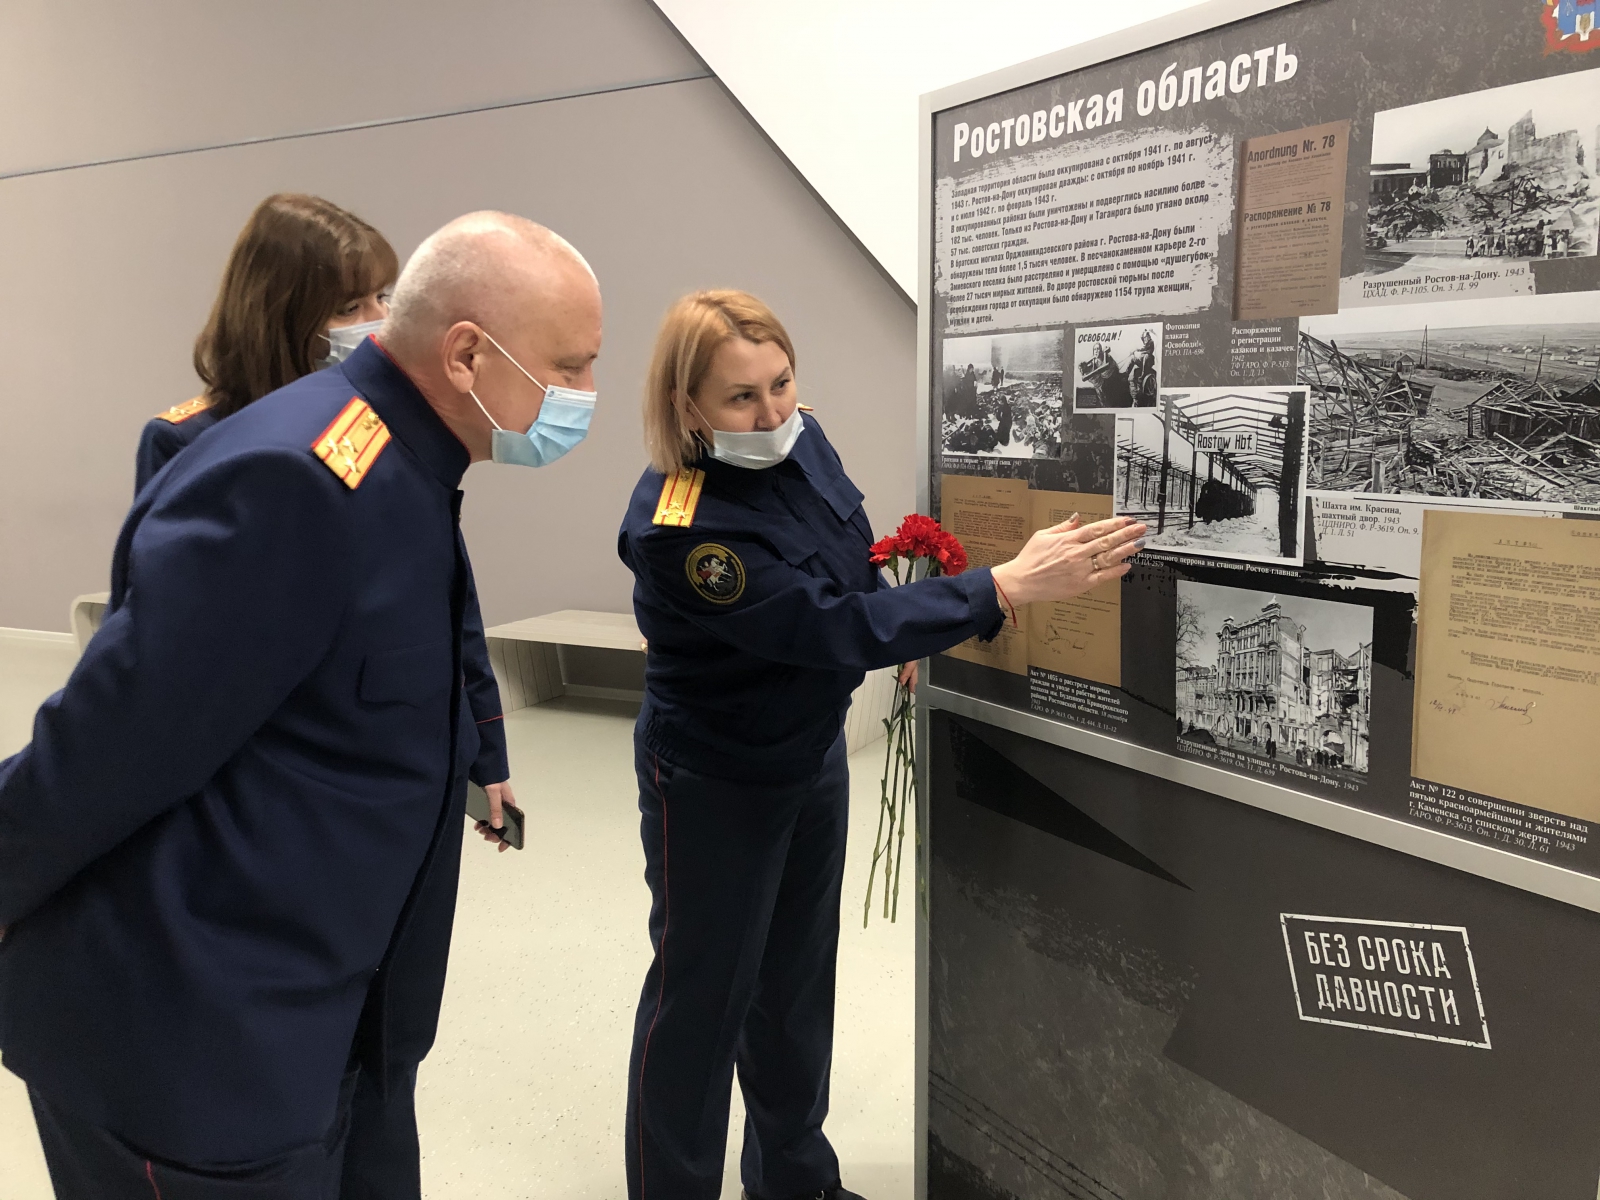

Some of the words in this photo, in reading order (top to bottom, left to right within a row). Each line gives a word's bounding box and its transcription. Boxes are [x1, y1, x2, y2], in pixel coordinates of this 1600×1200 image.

[954, 88, 1123, 162] Ростовская
[1137, 43, 1298, 116] область
[1248, 144, 1298, 163] Anordnung
[1303, 139, 1316, 153] Nr.
[1322, 135, 1335, 149] 78
[1012, 173, 1036, 186] области
[1038, 168, 1055, 180] была
[1057, 158, 1104, 175] оккупирована
[1112, 150, 1141, 164] октября
[1144, 144, 1161, 156] 1941
[1164, 144, 1170, 152] г.
[1174, 142, 1183, 150] по
[972, 190, 1016, 206] Ростов-на-Дону
[1018, 182, 1057, 196] оккупирован
[1059, 175, 1088, 188] дважды:
[1097, 166, 1124, 180] октября
[1127, 166, 1136, 174] по
[1138, 158, 1164, 171] ноябрь
[1168, 153, 1186, 166] 1941
[977, 206, 990, 216] 1942
[998, 204, 1005, 212] по
[1006, 200, 1032, 212] февраль
[1034, 194, 1049, 205] 1943
[1028, 208, 1045, 219] были
[1047, 202, 1087, 217] уничтожены
[1090, 200, 1094, 208] и
[1096, 192, 1142, 206] подверглись
[1144, 184, 1178, 198] насилию
[1182, 180, 1205, 192] более
[1244, 206, 1302, 222] Распоряжение
[1321, 201, 1331, 212] 78
[976, 230, 1000, 240] человек.
[1002, 225, 1022, 236] Только
[1024, 224, 1031, 232] из
[1033, 215, 1087, 231] Ростова-на-Дону
[1096, 207, 1131, 220] Таганрога
[1134, 203, 1153, 214] было
[1156, 198, 1182, 212] угнано
[1185, 194, 1209, 205] около
[985, 266, 997, 274] тела
[999, 264, 1016, 272] более
[1018, 261, 1027, 271] 1,5
[1029, 260, 1048, 269] тысяч
[1050, 256, 1078, 266] человек.
[1081, 252, 1085, 261] В
[1088, 244, 1152, 260] песчанокаменном
[1155, 240, 1186, 252] карьере
[1189, 237, 1206, 247] 2-го
[1002, 238, 1029, 249] граждан.
[1006, 243, 1072, 261] Орджоникидзевского
[1074, 239, 1098, 251] района
[1109, 228, 1171, 244] Ростова-на-Дону
[1174, 225, 1195, 235] были
[1007, 275, 1022, 283] было
[1024, 270, 1063, 283] расстреляно
[1072, 264, 1114, 277] умерщвлено
[1123, 258, 1158, 269] помощью
[1161, 251, 1213, 266] «душегубок»
[1363, 277, 1421, 290] Разрушенный
[1425, 271, 1500, 283] Ростов-на-Дону.
[1505, 268, 1525, 277] 1943
[966, 292, 973, 300] 27
[1017, 284, 1044, 295] жителей.
[1047, 282, 1054, 291] Во
[1056, 281, 1075, 291] дворе
[1078, 275, 1116, 290] ростовской
[1119, 272, 1149, 284] тюрьмы
[1152, 270, 1174, 280] после
[990, 301, 1009, 311] города
[1011, 300, 1017, 308] от
[1052, 292, 1069, 304] было
[1071, 290, 1112, 302] обнаружено
[1115, 287, 1132, 297] 1154
[1134, 286, 1155, 297] трупа
[1158, 282, 1192, 293] женщин,
[1402, 286, 1429, 295] Р-1105.
[1078, 330, 1122, 343] ОСВОБОДИ!
[1165, 332, 1189, 340] плаката
[1232, 326, 1282, 336] Распоряжение
[1238, 336, 1281, 345] регистрации
[1231, 346, 1257, 354] казаков
[1267, 345, 1296, 353] казачек.
[1198, 434, 1231, 449] Rostow
[1322, 501, 1347, 510] Шахта
[1366, 504, 1401, 515] Красина,
[1359, 515, 1380, 524] двор.
[1180, 557, 1205, 565] перрона
[1216, 562, 1244, 570] станции
[1280, 764, 1340, 788] Ростова-на-Дону.
[1344, 782, 1359, 791] 1943
[1409, 791, 1436, 803] пятью
[1439, 799, 1521, 826] красноармейцами
[1535, 824, 1586, 843] жителями
[1410, 780, 1426, 791] Акт
[1442, 788, 1456, 798] 122
[1468, 797, 1525, 816] совершении
[1528, 812, 1566, 827] зверств
[1570, 822, 1588, 834] над
[1409, 808, 1432, 821] ГАРО.
[1435, 816, 1443, 824] Ф.
[1446, 818, 1474, 832] Р-3613.
[1477, 827, 1490, 837] Оп.
[1502, 834, 1511, 843] Д.
[1514, 838, 1525, 847] 30.
[1539, 845, 1549, 853] 61
[1418, 801, 1459, 820] Каменска
[1475, 819, 1515, 835] списком
[1518, 830, 1550, 845] жертв.
[1556, 840, 1575, 851] 1943
[1304, 931, 1350, 968] БЕЗ
[1357, 936, 1452, 979] СРОКА
[1316, 973, 1460, 1026] ДАВНОСТИ
